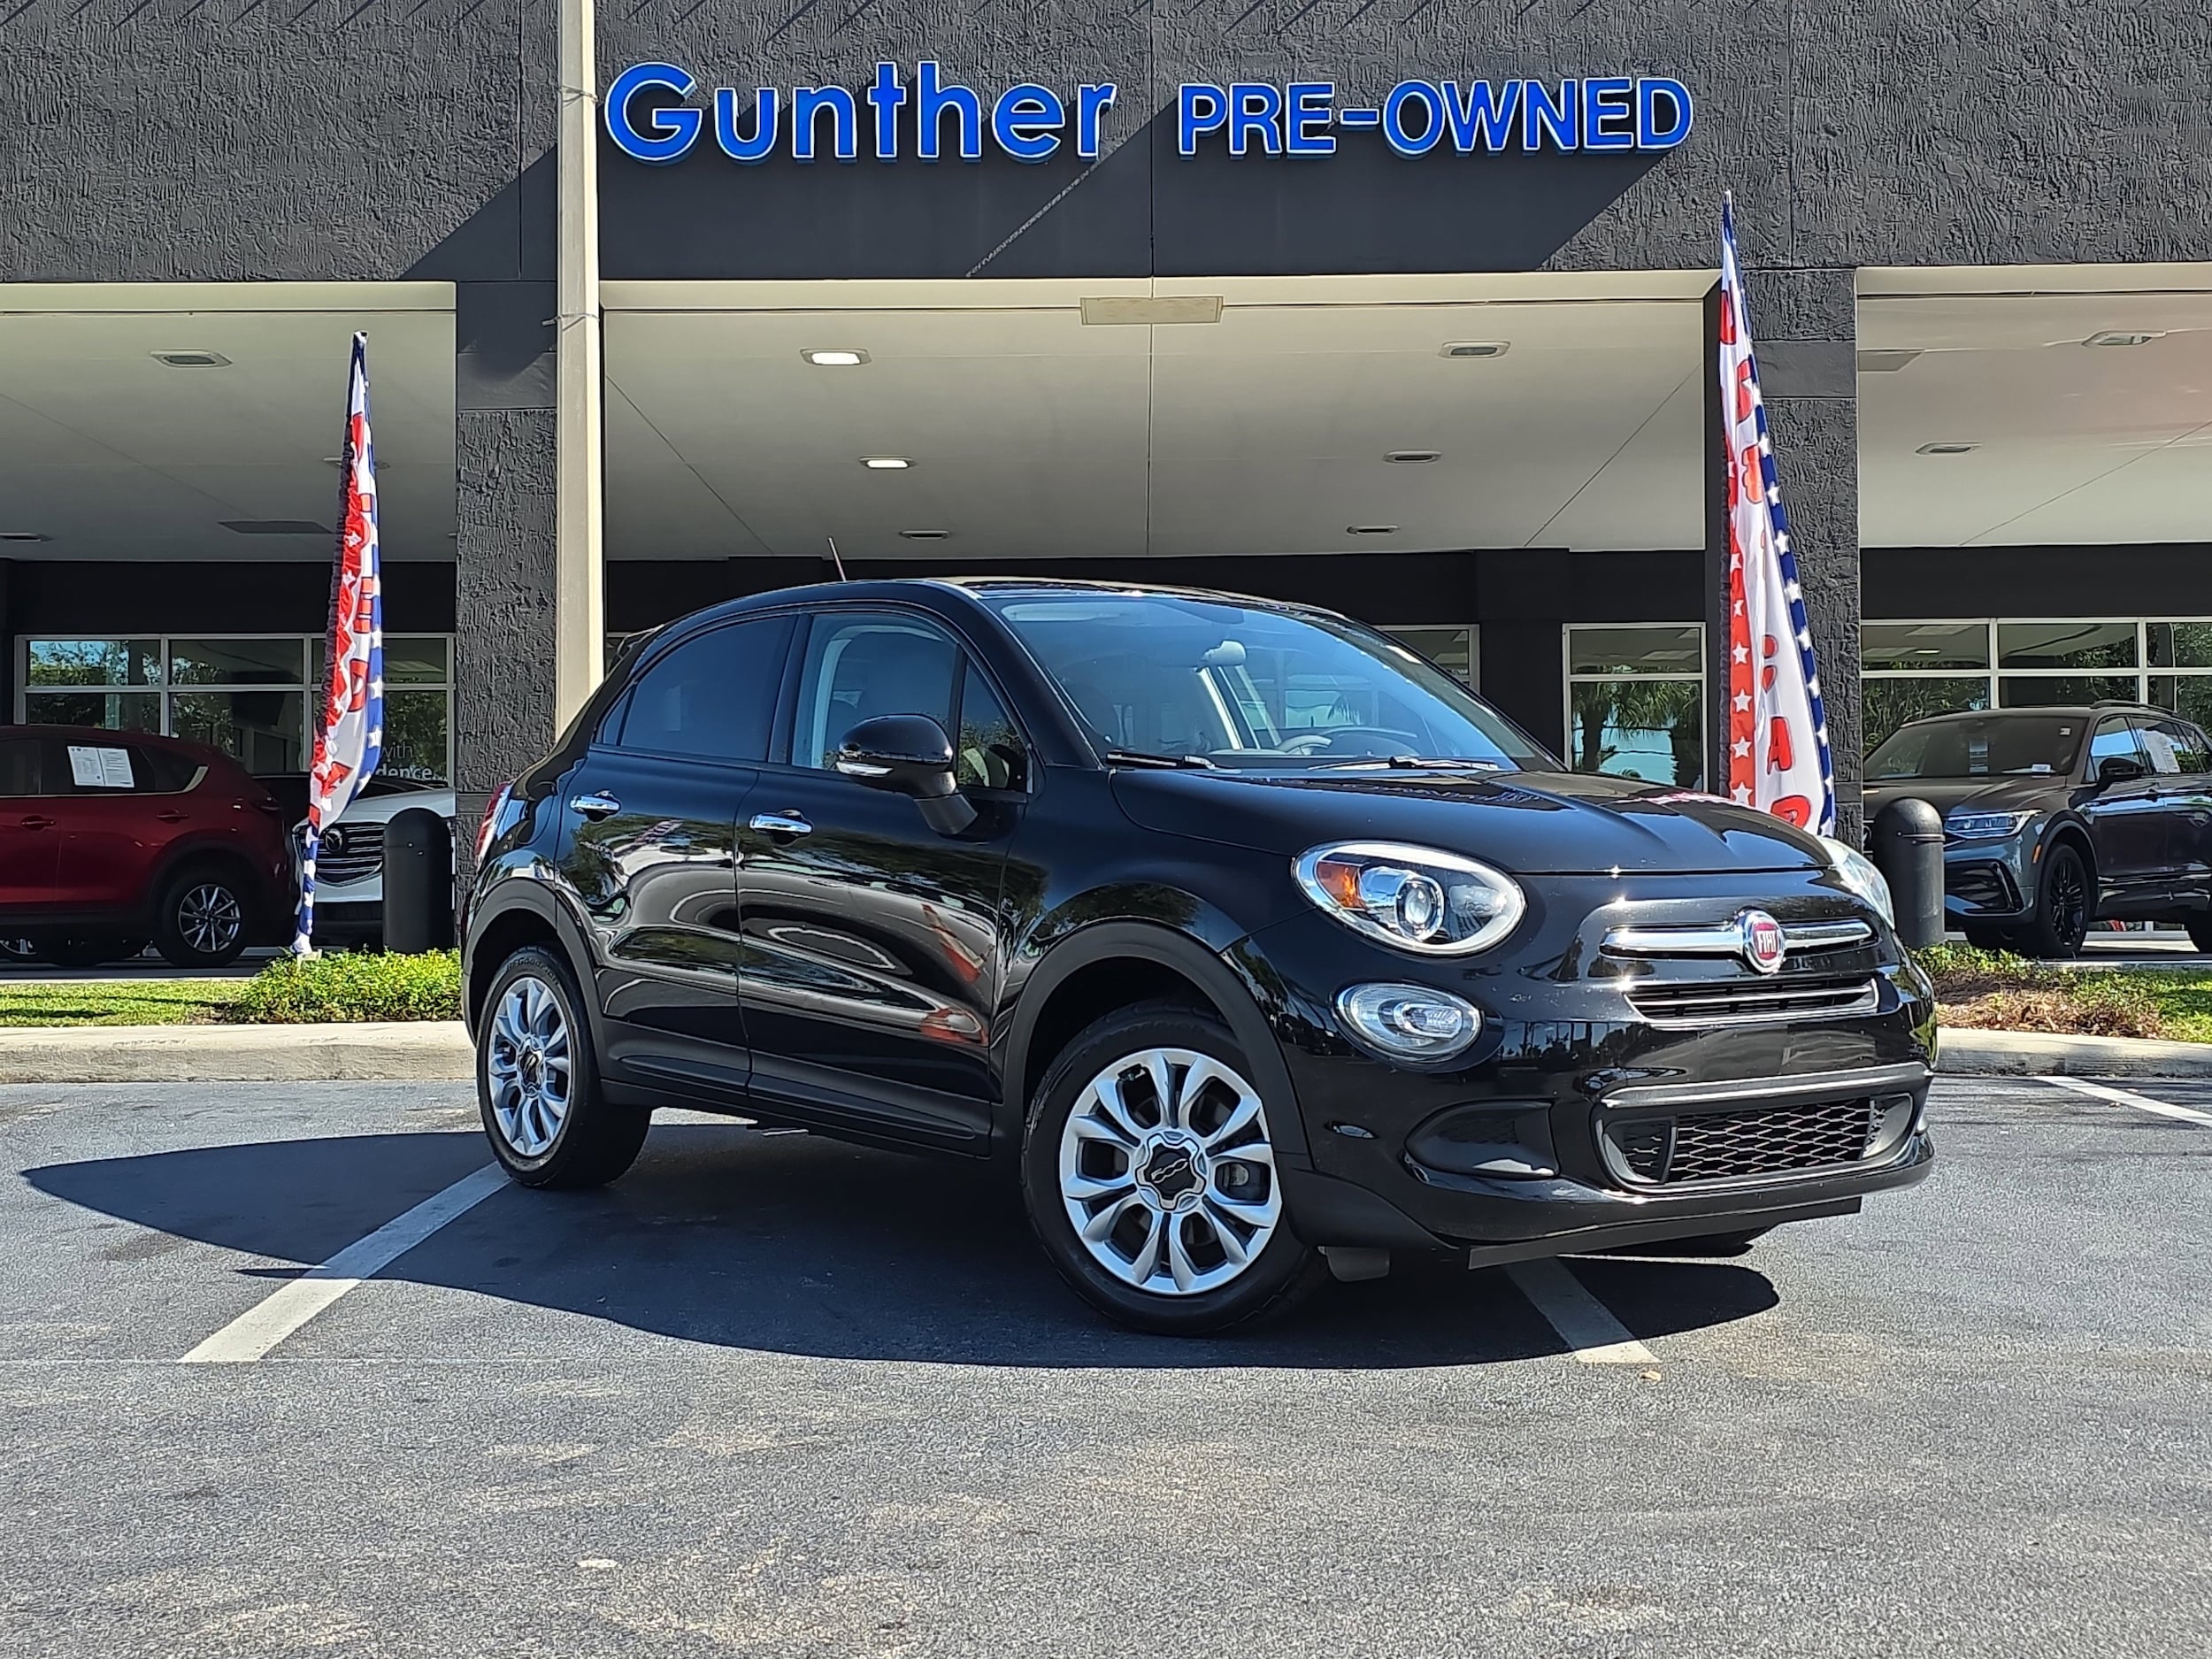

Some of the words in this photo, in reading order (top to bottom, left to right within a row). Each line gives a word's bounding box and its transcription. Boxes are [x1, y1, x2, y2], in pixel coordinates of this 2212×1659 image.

[604, 61, 1117, 163] Gunther
[1178, 77, 1694, 156] PRE-OWNED
[1755, 930, 1777, 954] FIAT
